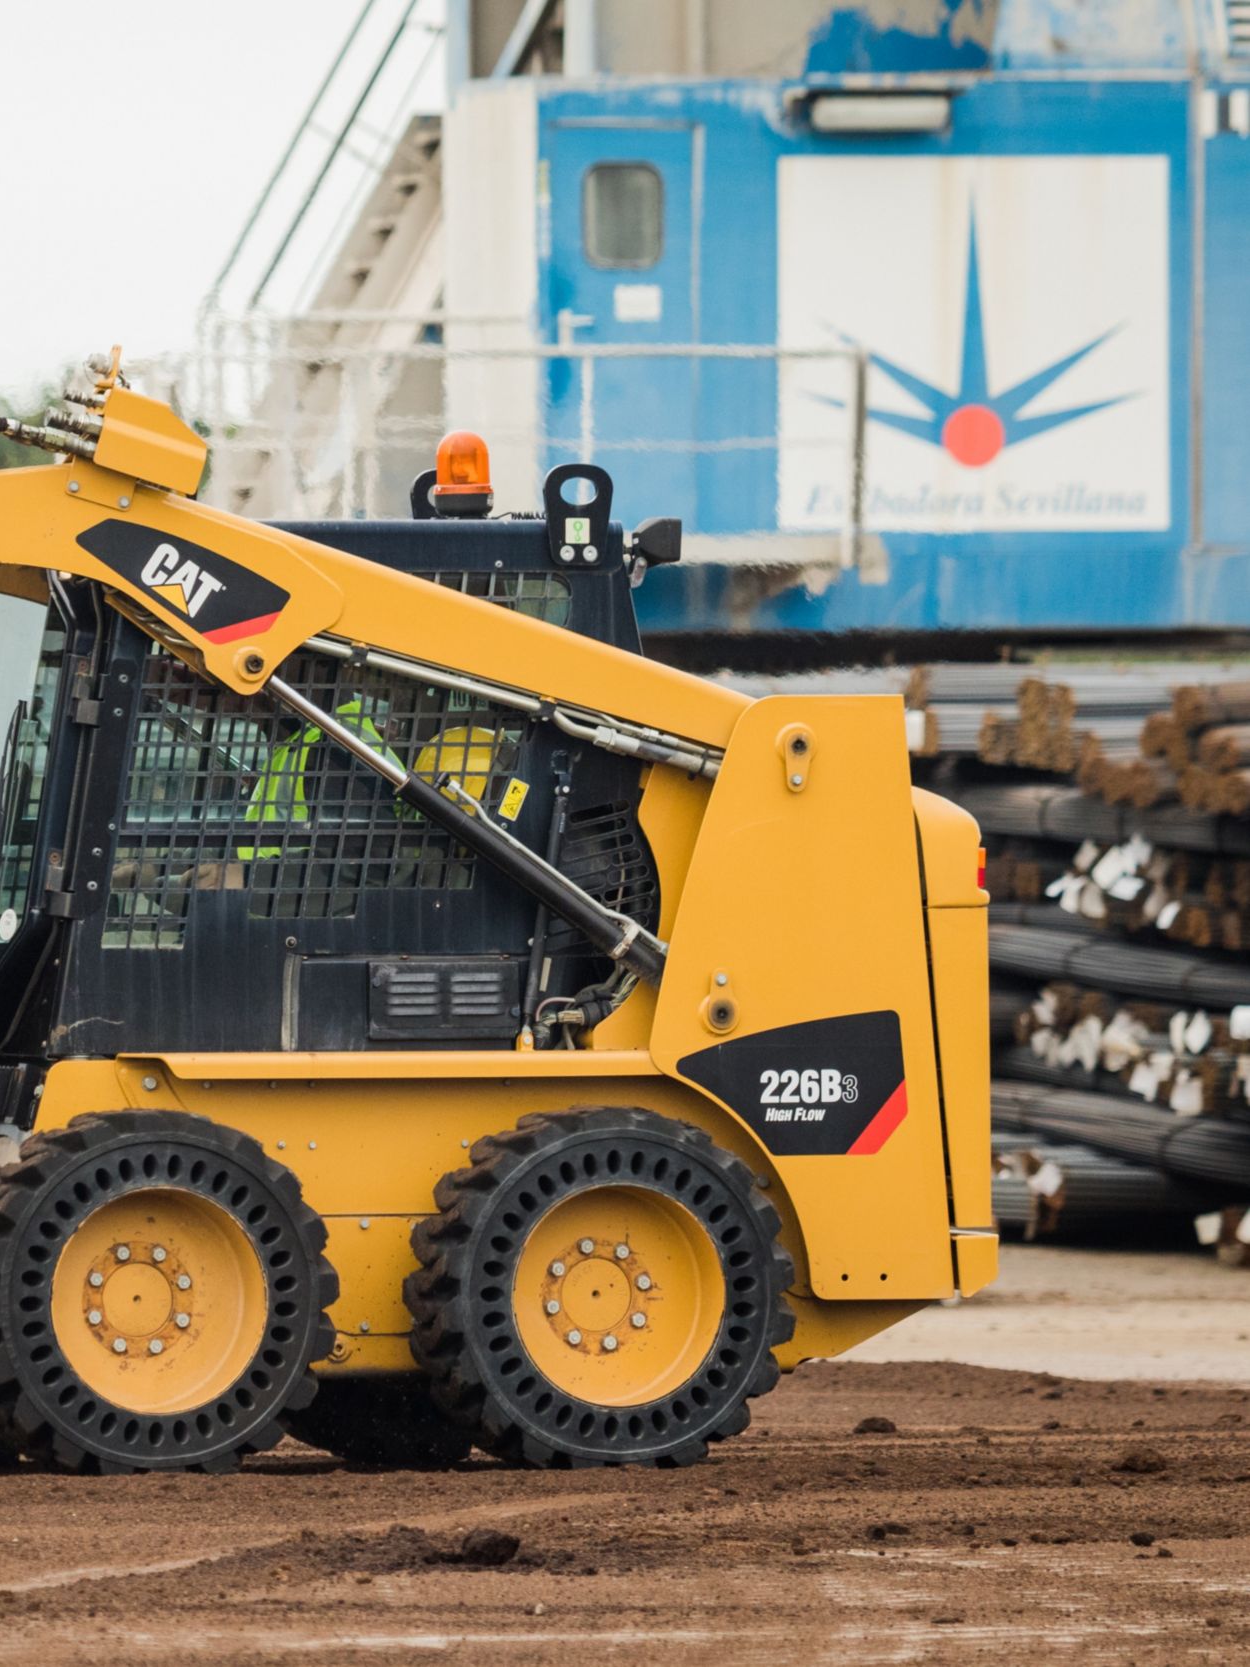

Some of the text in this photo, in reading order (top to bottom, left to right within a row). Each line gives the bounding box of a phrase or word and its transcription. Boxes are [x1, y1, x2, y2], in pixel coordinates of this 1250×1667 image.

[995, 482, 1148, 516] Sevillana
[141, 543, 224, 618] CAT
[760, 1068, 858, 1103] 226B3
[765, 1107, 826, 1122] HIGH FLOW
